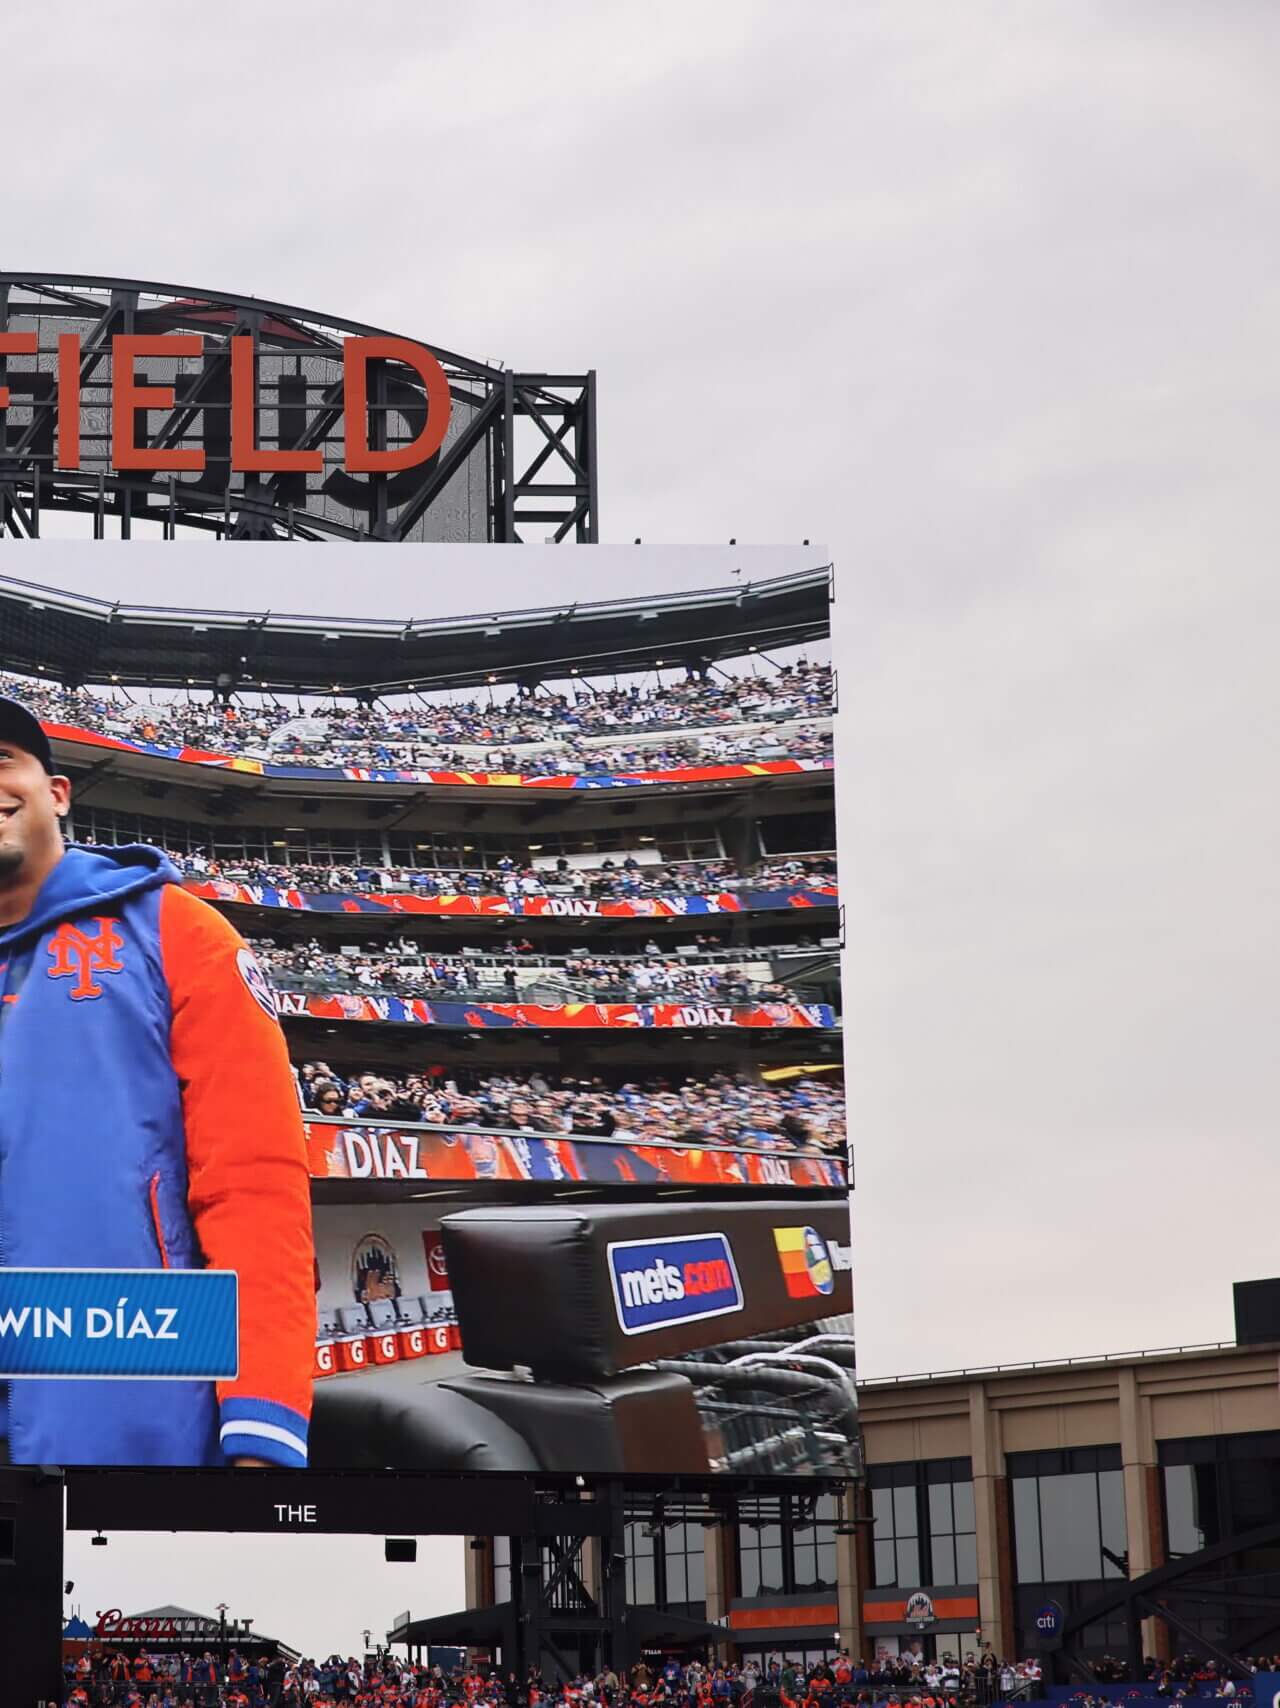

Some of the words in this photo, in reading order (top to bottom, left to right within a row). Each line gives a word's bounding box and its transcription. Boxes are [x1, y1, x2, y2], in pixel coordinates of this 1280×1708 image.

[85, 1297, 180, 1340] DÍAZ
[381, 1336, 395, 1358] G
[410, 1331, 423, 1353] G
[434, 1327, 448, 1348] G
[317, 1346, 332, 1370] G
[351, 1340, 364, 1364] G
[273, 1504, 317, 1522] THE
[95, 1608, 177, 1639] Coors
